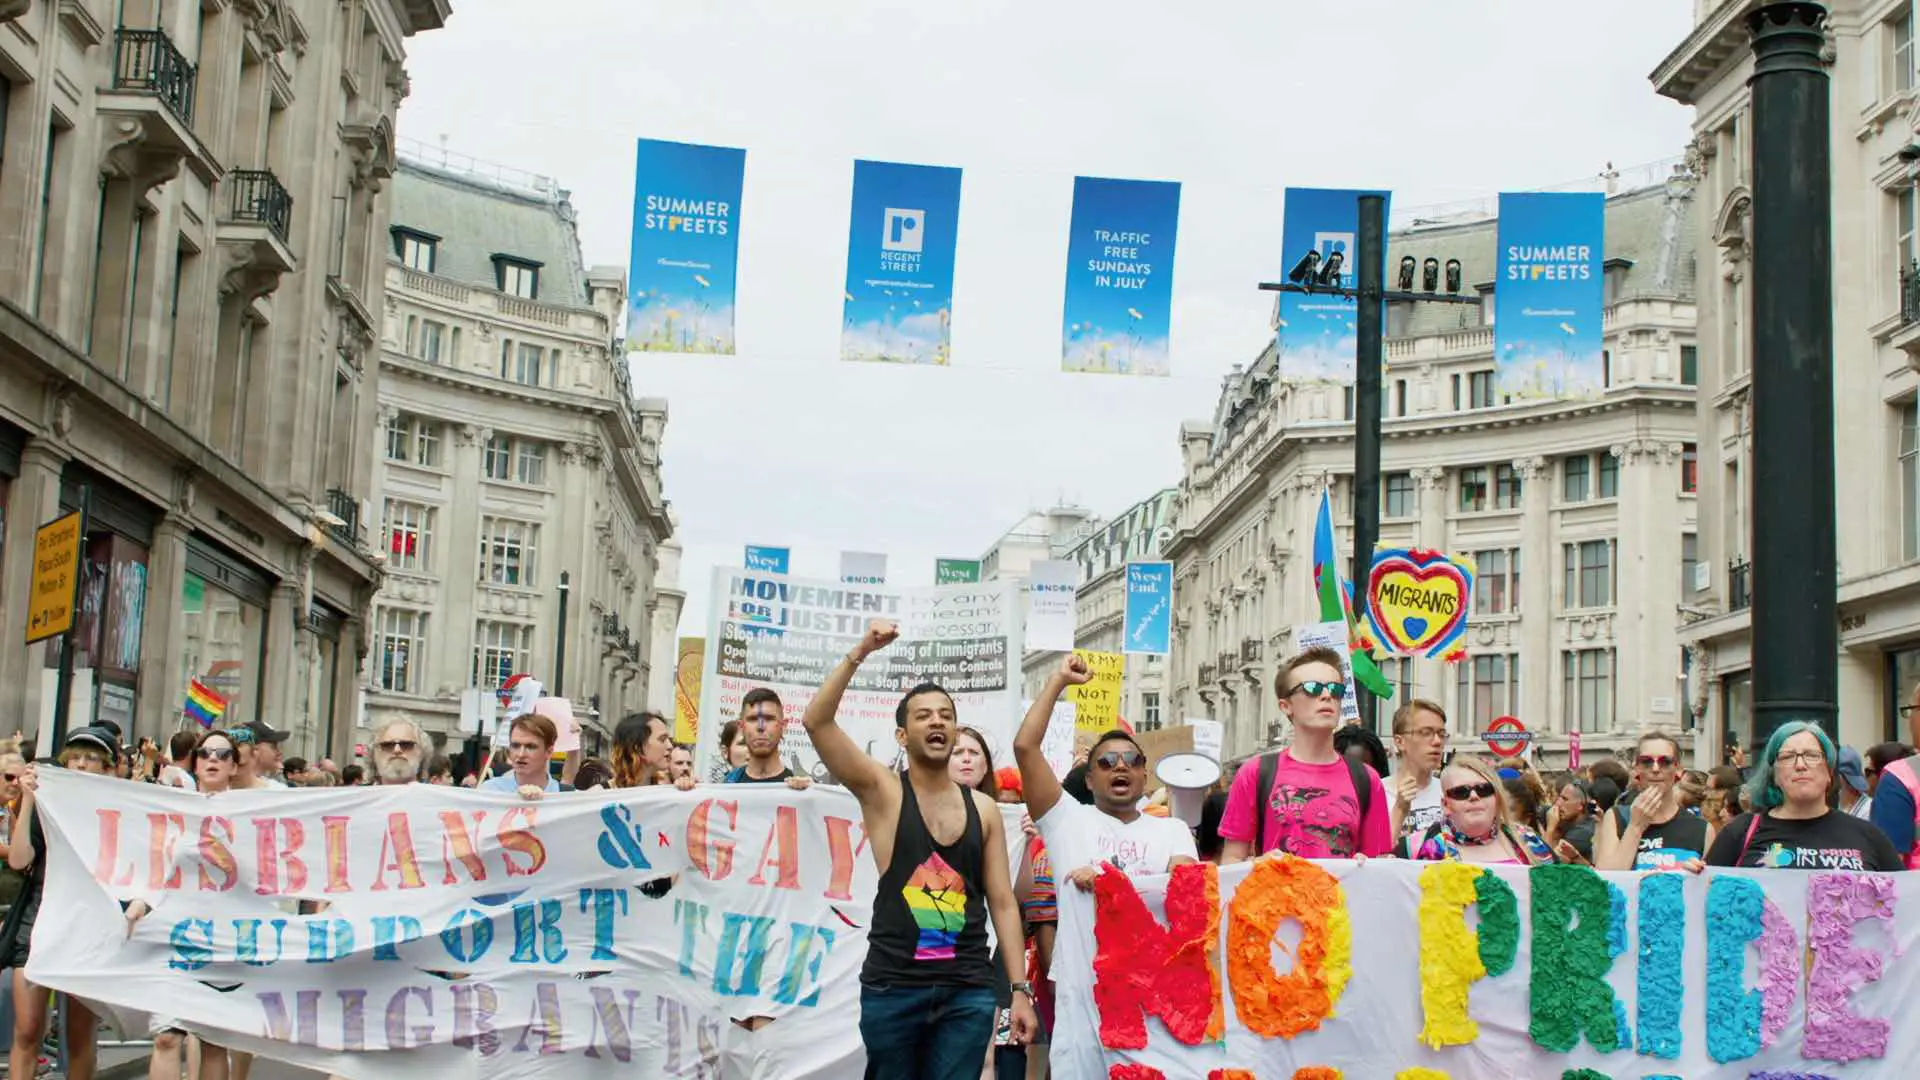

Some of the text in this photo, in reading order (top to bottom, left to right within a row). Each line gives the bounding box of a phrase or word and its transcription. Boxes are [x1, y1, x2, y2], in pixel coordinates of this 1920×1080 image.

[646, 195, 729, 217] SUMMER
[1094, 230, 1151, 245] TRAFFIC
[881, 251, 922, 262] REGENT
[1104, 246, 1138, 259] FREE
[1508, 246, 1590, 261] SUMMER
[880, 261, 921, 272] STREET
[1087, 260, 1151, 275] SUNDAYS
[1095, 276, 1147, 289] IN JULY
[840, 576, 886, 584] LONDON
[1130, 571, 1164, 583] West
[730, 575, 901, 613] MOVEMENT
[1030, 583, 1075, 592] LONDON
[910, 592, 1001, 607] by any
[1379, 582, 1457, 616] MIGRANTS
[728, 599, 773, 624] FOR
[910, 608, 1001, 620] means
[909, 622, 1000, 637] necessary
[725, 620, 753, 645] Stop
[755, 627, 780, 643] the
[782, 632, 822, 650] Racist
[919, 643, 931, 657] of
[937, 639, 1004, 660] Immigrants
[723, 643, 753, 660] Open
[887, 659, 957, 675] Immigration
[959, 658, 1003, 673] Controls
[722, 658, 745, 674] Shut
[747, 661, 775, 676] Down
[875, 676, 899, 691] Stop
[1077, 688, 1110, 701] NOT
[1095, 703, 1112, 715] MY
[95, 805, 548, 895] LESBIANS
[597, 802, 651, 870] &
[1796, 847, 1863, 857] NO PRIDE
[1796, 855, 1865, 871] IN WAR
[674, 898, 836, 1008] THE
[1093, 857, 1902, 1065] NO PRIDE
[256, 982, 722, 1080] MIGRANTS
